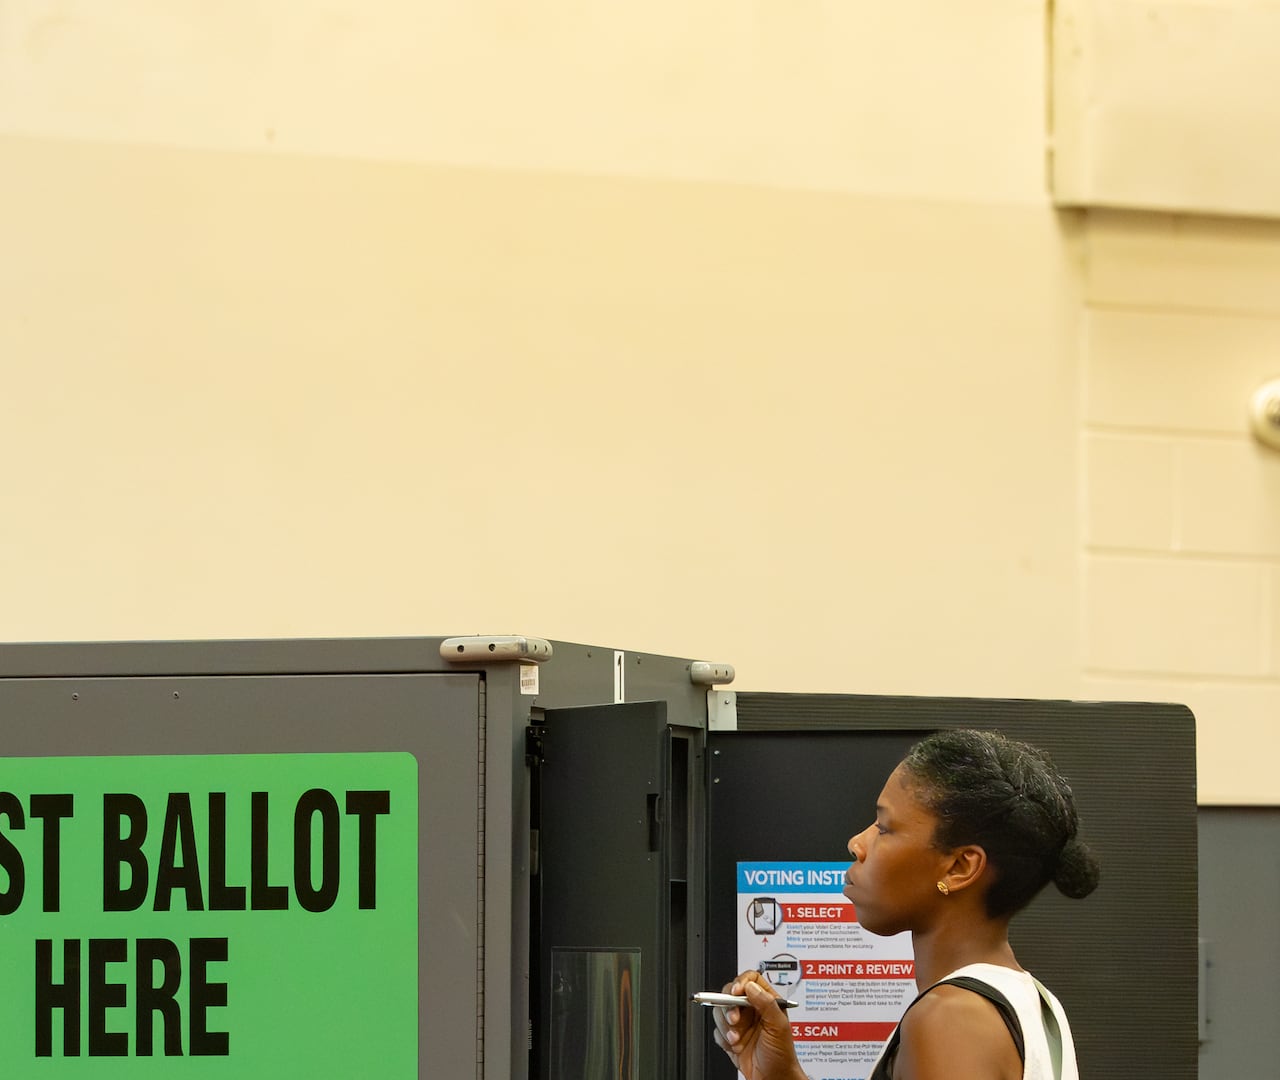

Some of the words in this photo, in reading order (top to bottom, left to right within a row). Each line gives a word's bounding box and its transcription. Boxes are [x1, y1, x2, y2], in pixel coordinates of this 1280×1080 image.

[102, 788, 391, 913] BALLOT
[744, 870, 804, 885] VOTING
[786, 907, 795, 918] 1.
[797, 907, 843, 918] SELECT
[806, 964, 816, 975] 2.
[818, 964, 854, 975] PRINT
[855, 964, 864, 975] &
[866, 964, 913, 975] REVIEW
[35, 937, 230, 1057] HERE
[792, 1026, 802, 1036] 3.
[804, 1026, 838, 1036] SCAN
